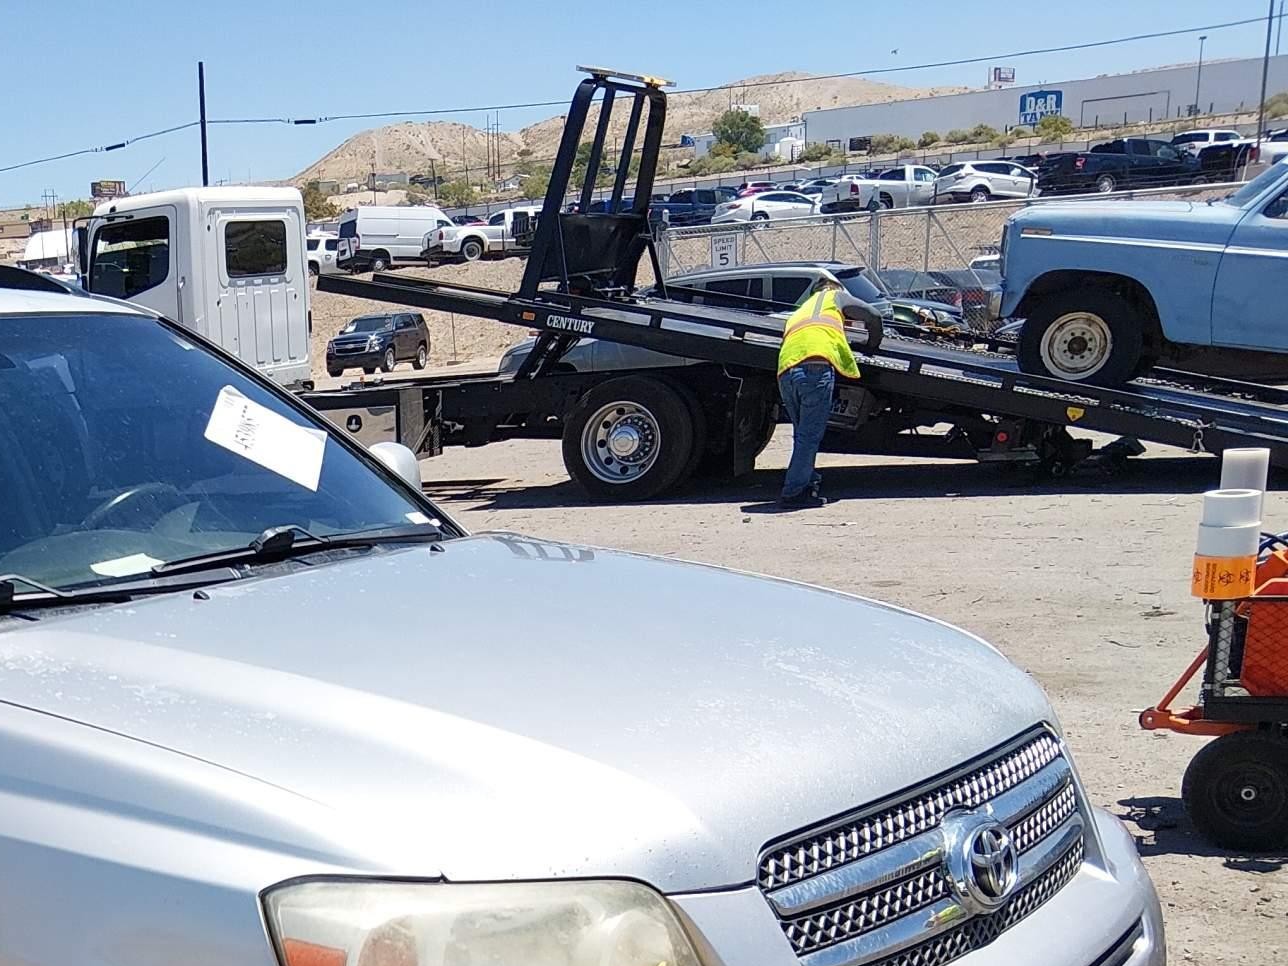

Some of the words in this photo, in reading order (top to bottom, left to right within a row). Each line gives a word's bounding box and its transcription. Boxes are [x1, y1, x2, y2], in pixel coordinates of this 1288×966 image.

[1025, 94, 1057, 113] D&R
[713, 237, 735, 245] SPEED
[715, 244, 733, 252] LIMIT
[719, 253, 729, 266] 5
[546, 314, 595, 334] CENTURY
